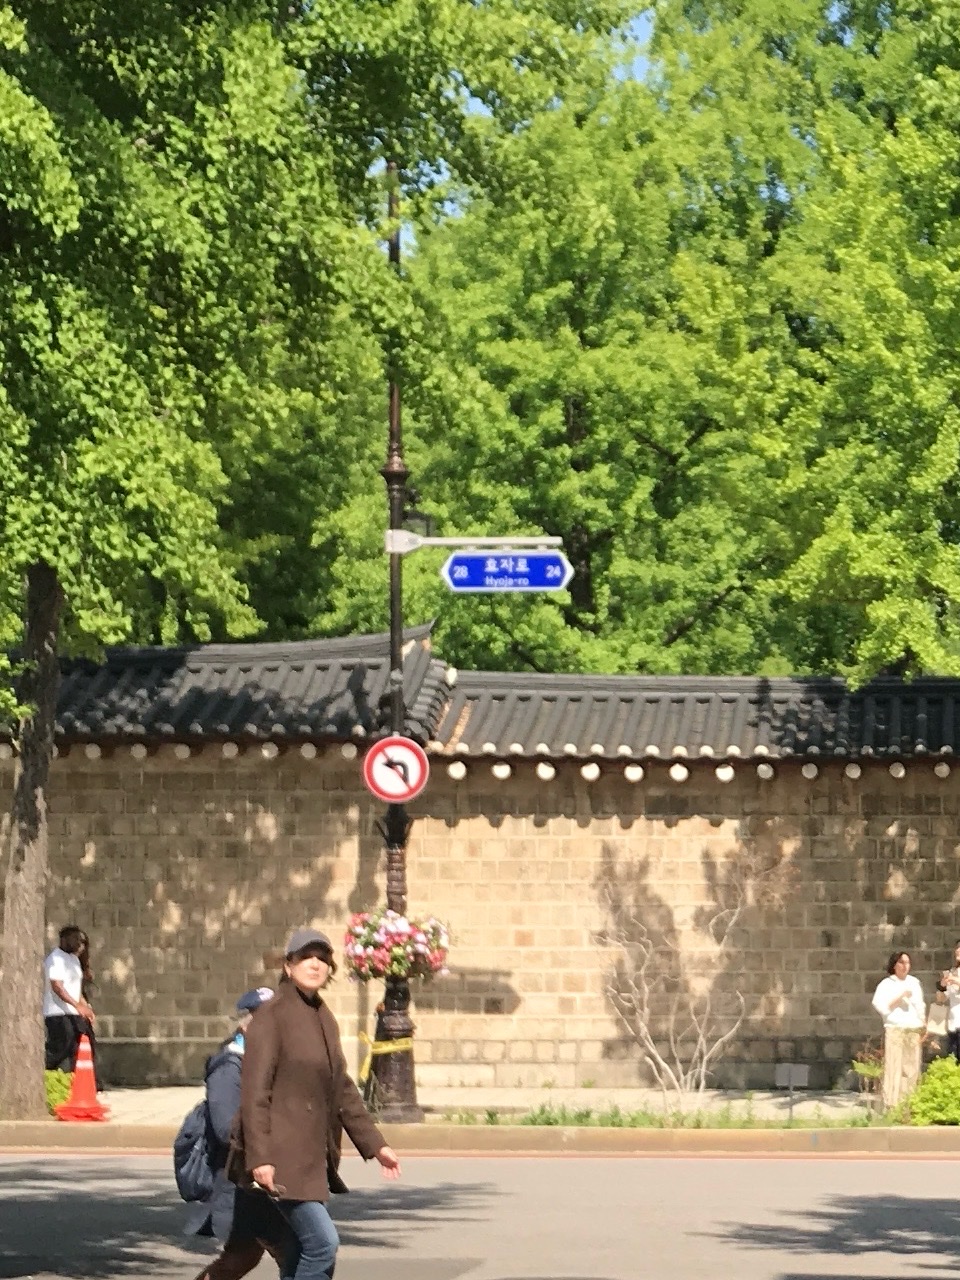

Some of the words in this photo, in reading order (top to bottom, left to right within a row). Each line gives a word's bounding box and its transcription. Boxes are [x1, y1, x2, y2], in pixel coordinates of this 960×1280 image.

[484, 558, 530, 573] 효자로
[546, 565, 561, 578] 24
[485, 576, 529, 587] Hyoja-ro
